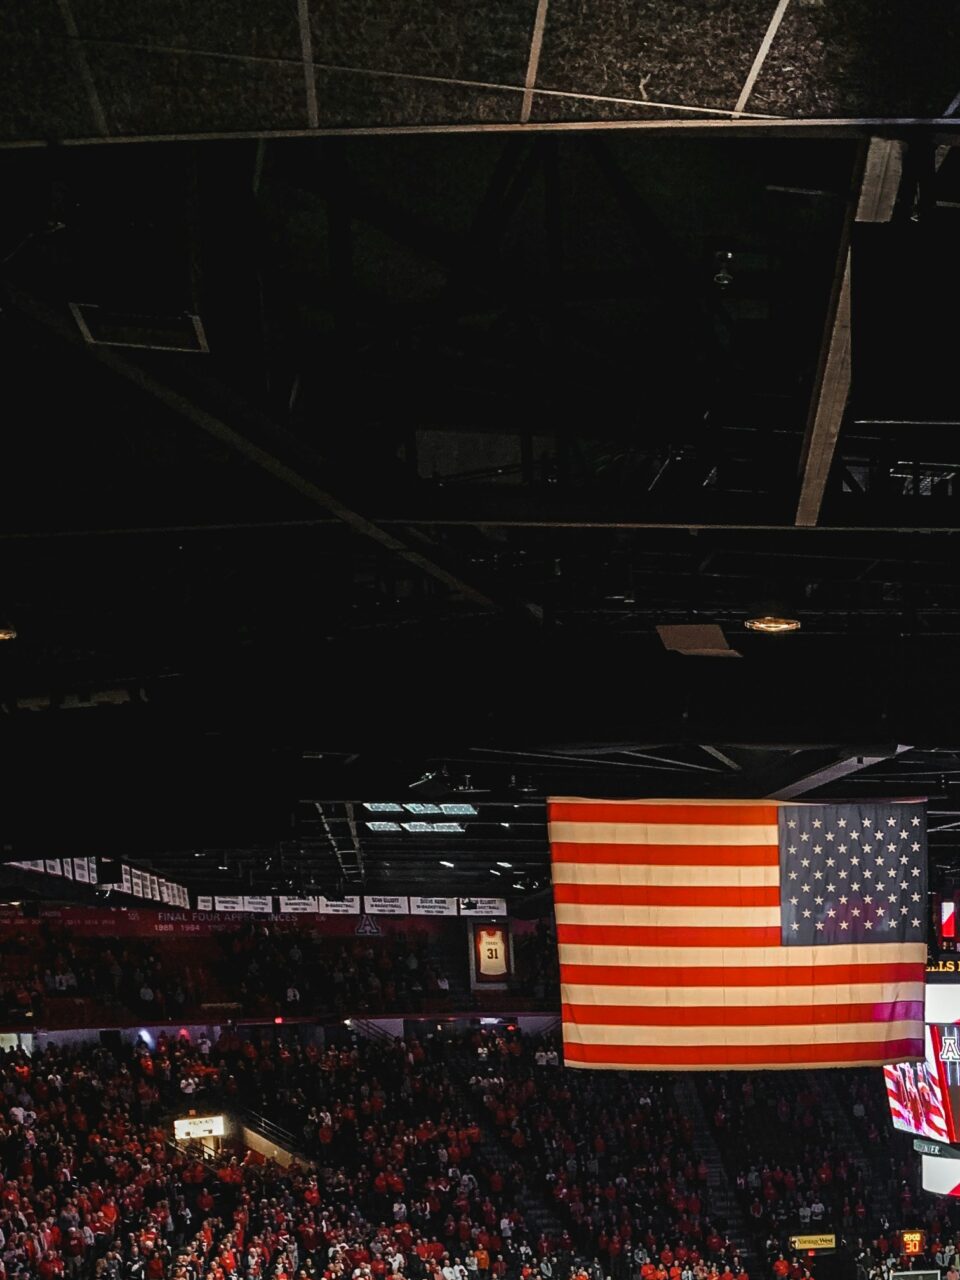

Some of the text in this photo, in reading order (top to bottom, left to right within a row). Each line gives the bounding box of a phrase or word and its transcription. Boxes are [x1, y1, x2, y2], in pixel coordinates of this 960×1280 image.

[158, 912, 188, 921] FINAL
[192, 912, 221, 921] FOUR
[487, 948, 499, 959] 31
[905, 1242, 919, 1253] 30
